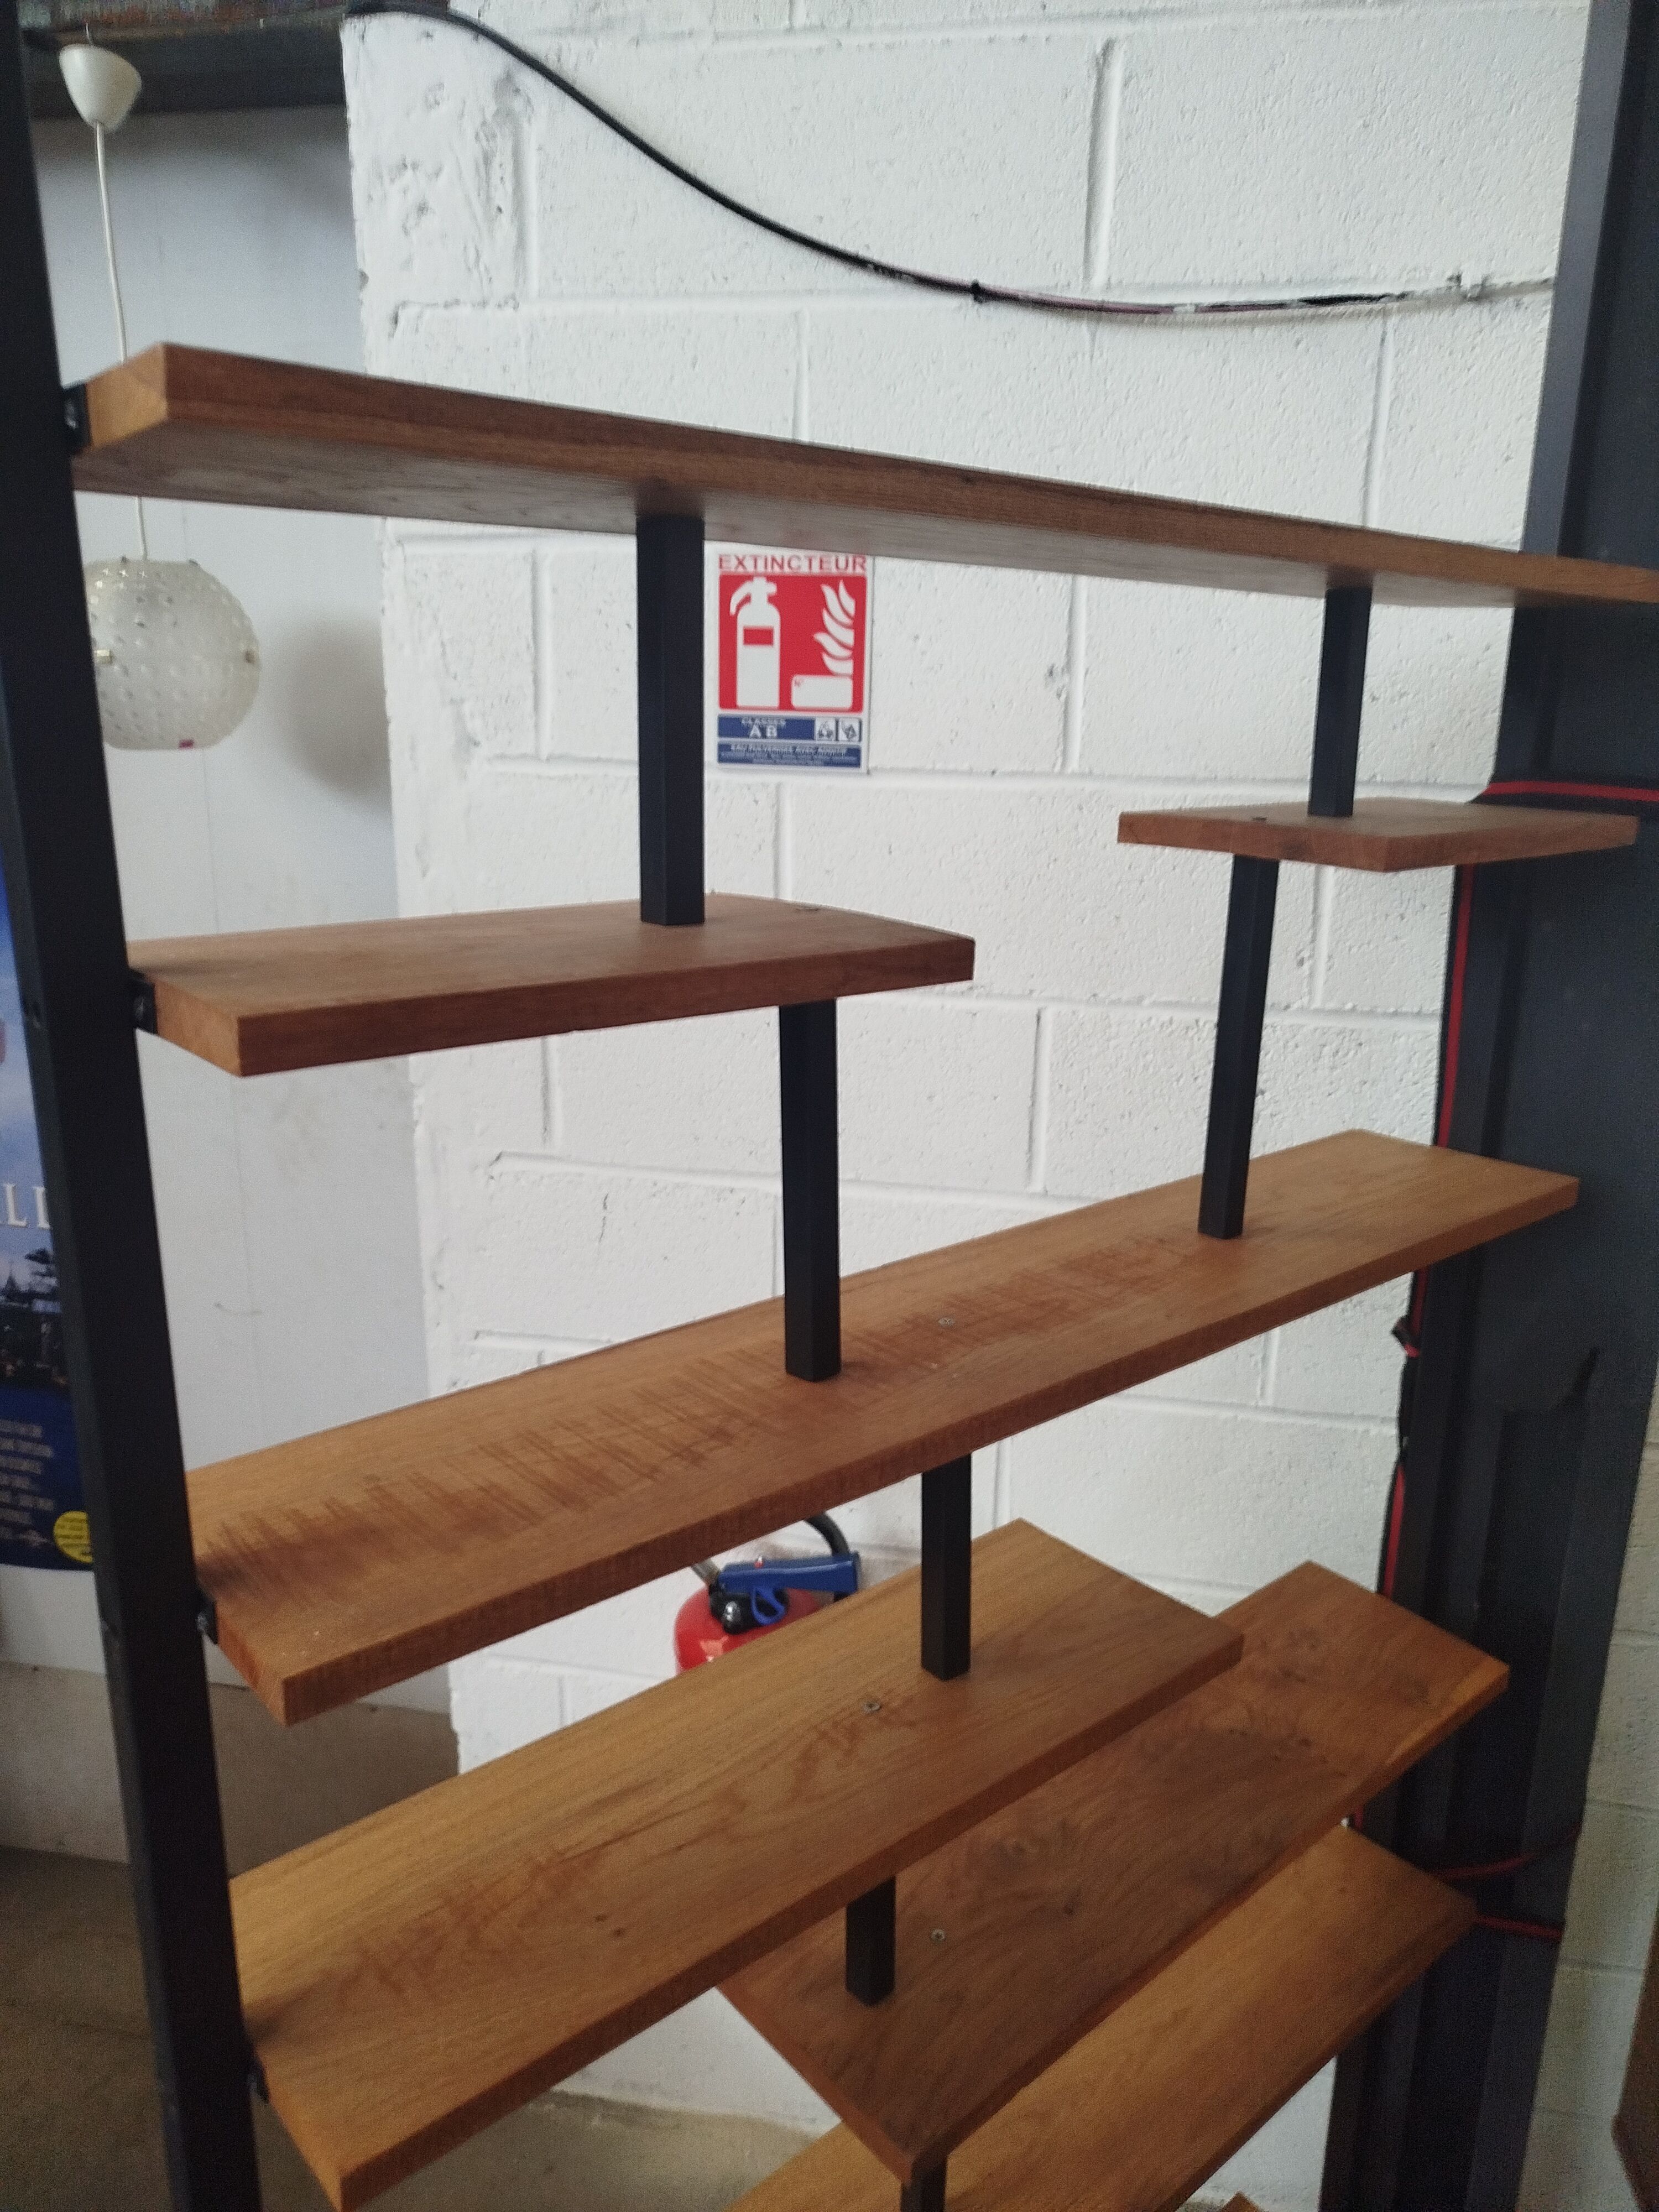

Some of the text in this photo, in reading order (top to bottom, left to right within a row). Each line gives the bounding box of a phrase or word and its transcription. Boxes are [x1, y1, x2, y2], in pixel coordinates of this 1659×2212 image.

[718, 554, 867, 571] EXTINCTEUR
[749, 724, 778, 738] A B
